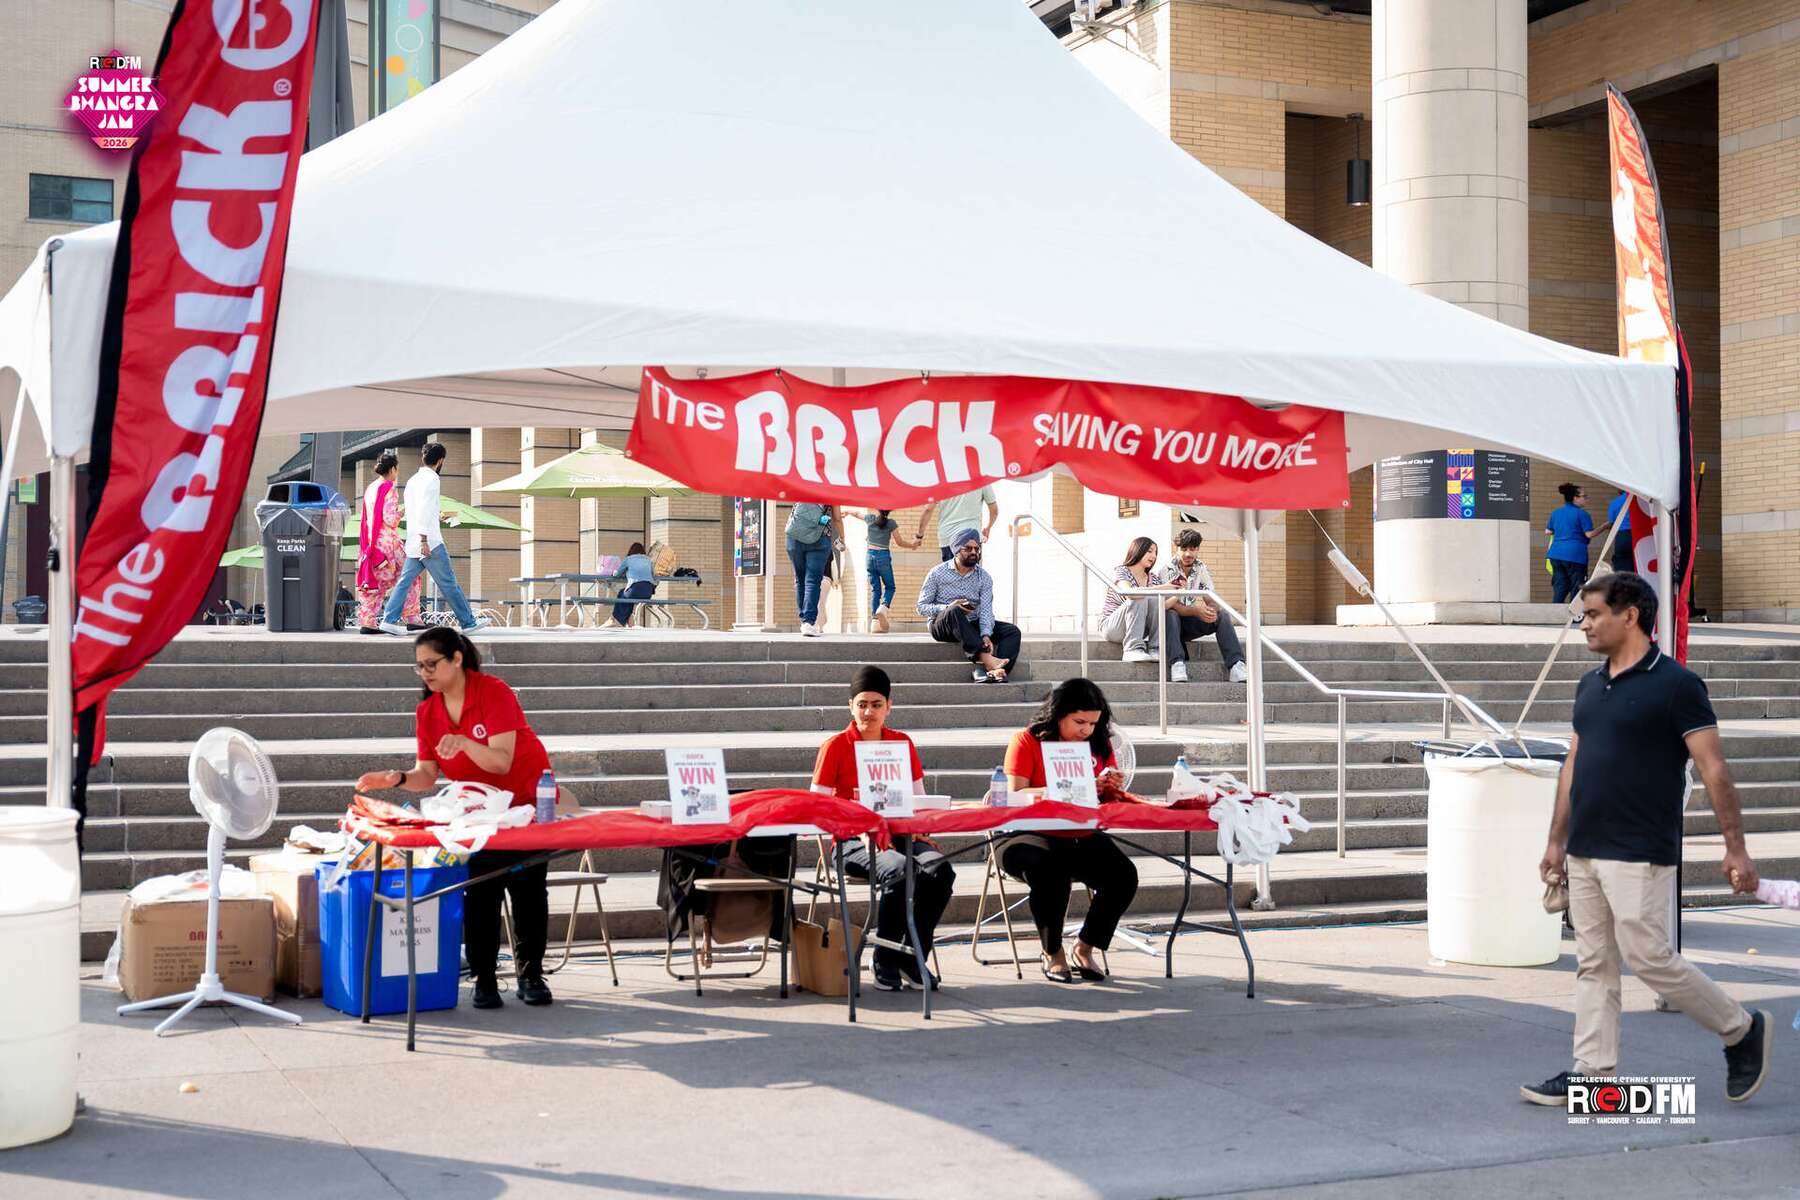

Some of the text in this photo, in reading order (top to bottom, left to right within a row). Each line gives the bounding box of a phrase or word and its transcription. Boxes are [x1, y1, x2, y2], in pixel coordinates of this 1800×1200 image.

[71, 99, 293, 647] The BRICK
[735, 390, 1006, 488] BRICK
[1033, 412, 1143, 455] SAVING
[1151, 427, 1217, 464] YOU
[1219, 432, 1318, 470] MORE
[678, 767, 716, 785] WIN
[867, 763, 901, 781] WIN
[1053, 761, 1085, 777] WIN
